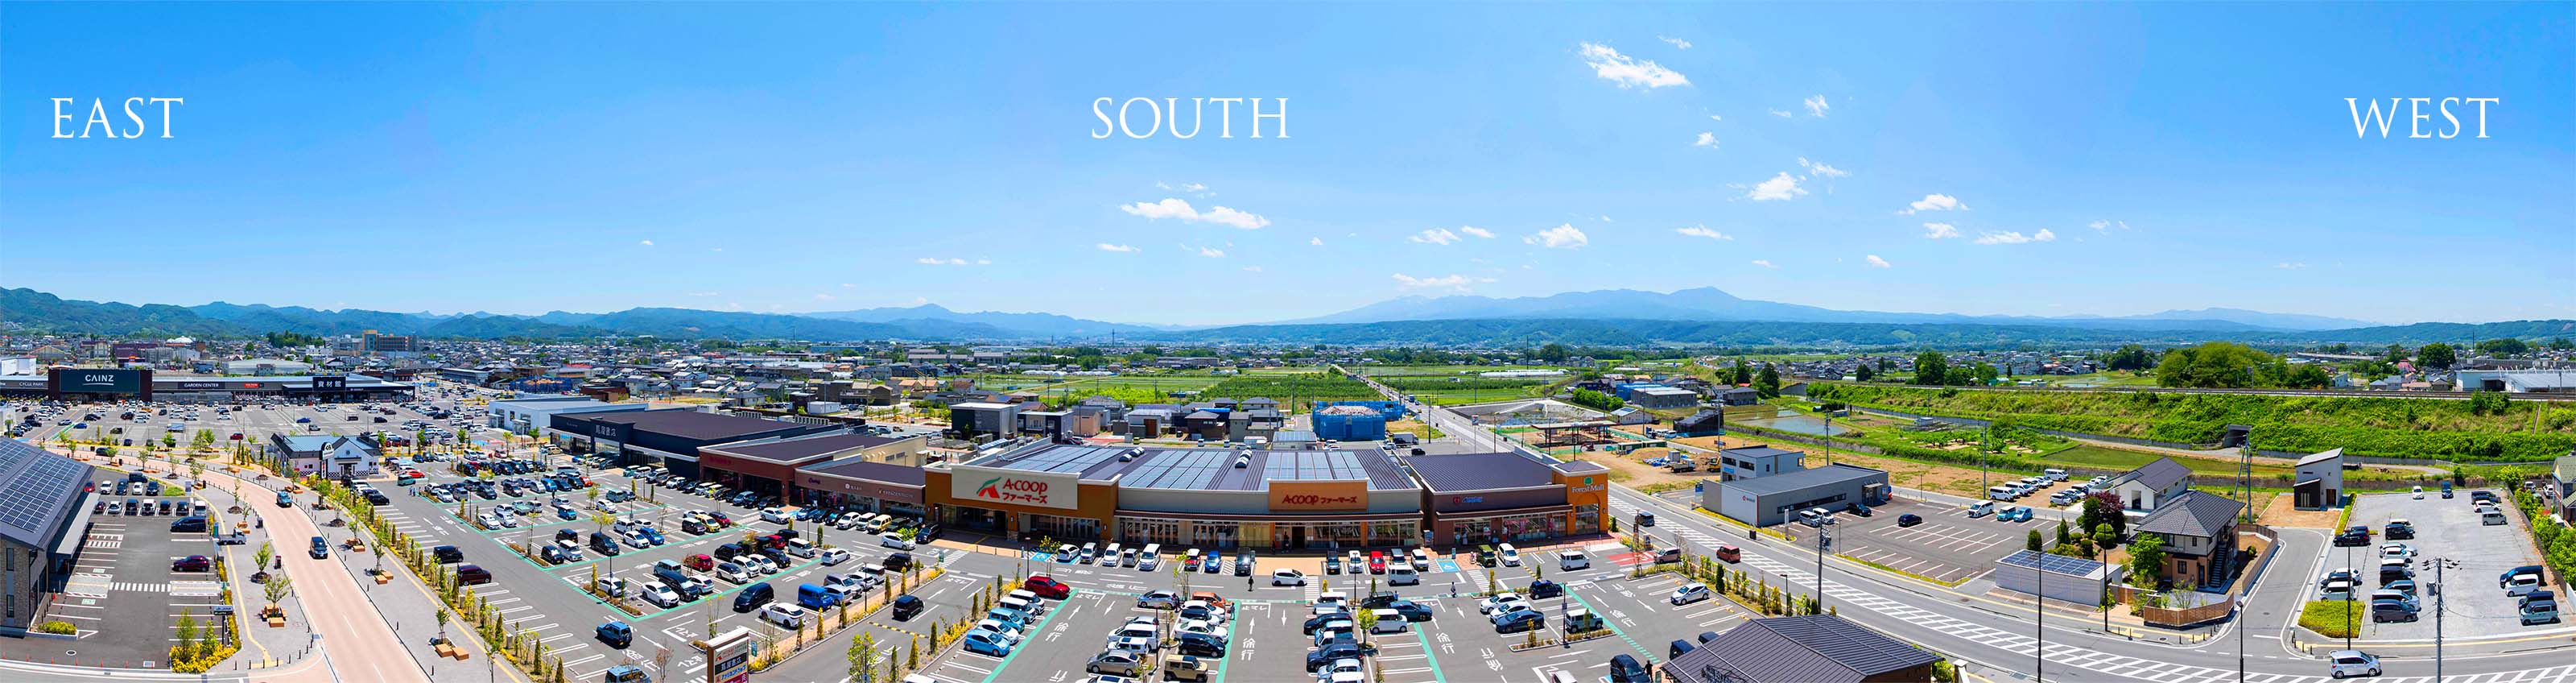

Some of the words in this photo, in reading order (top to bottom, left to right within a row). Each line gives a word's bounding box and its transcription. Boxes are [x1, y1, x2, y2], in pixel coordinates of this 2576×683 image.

[85, 374, 114, 383] CAINZ
[317, 380, 342, 388] 資材館
[1591, 484, 1604, 492] Mall
[1002, 492, 1048, 504] ファーマーズ
[1320, 495, 1358, 504] ファーマーズ
[1241, 637, 1257, 660] 徐行
